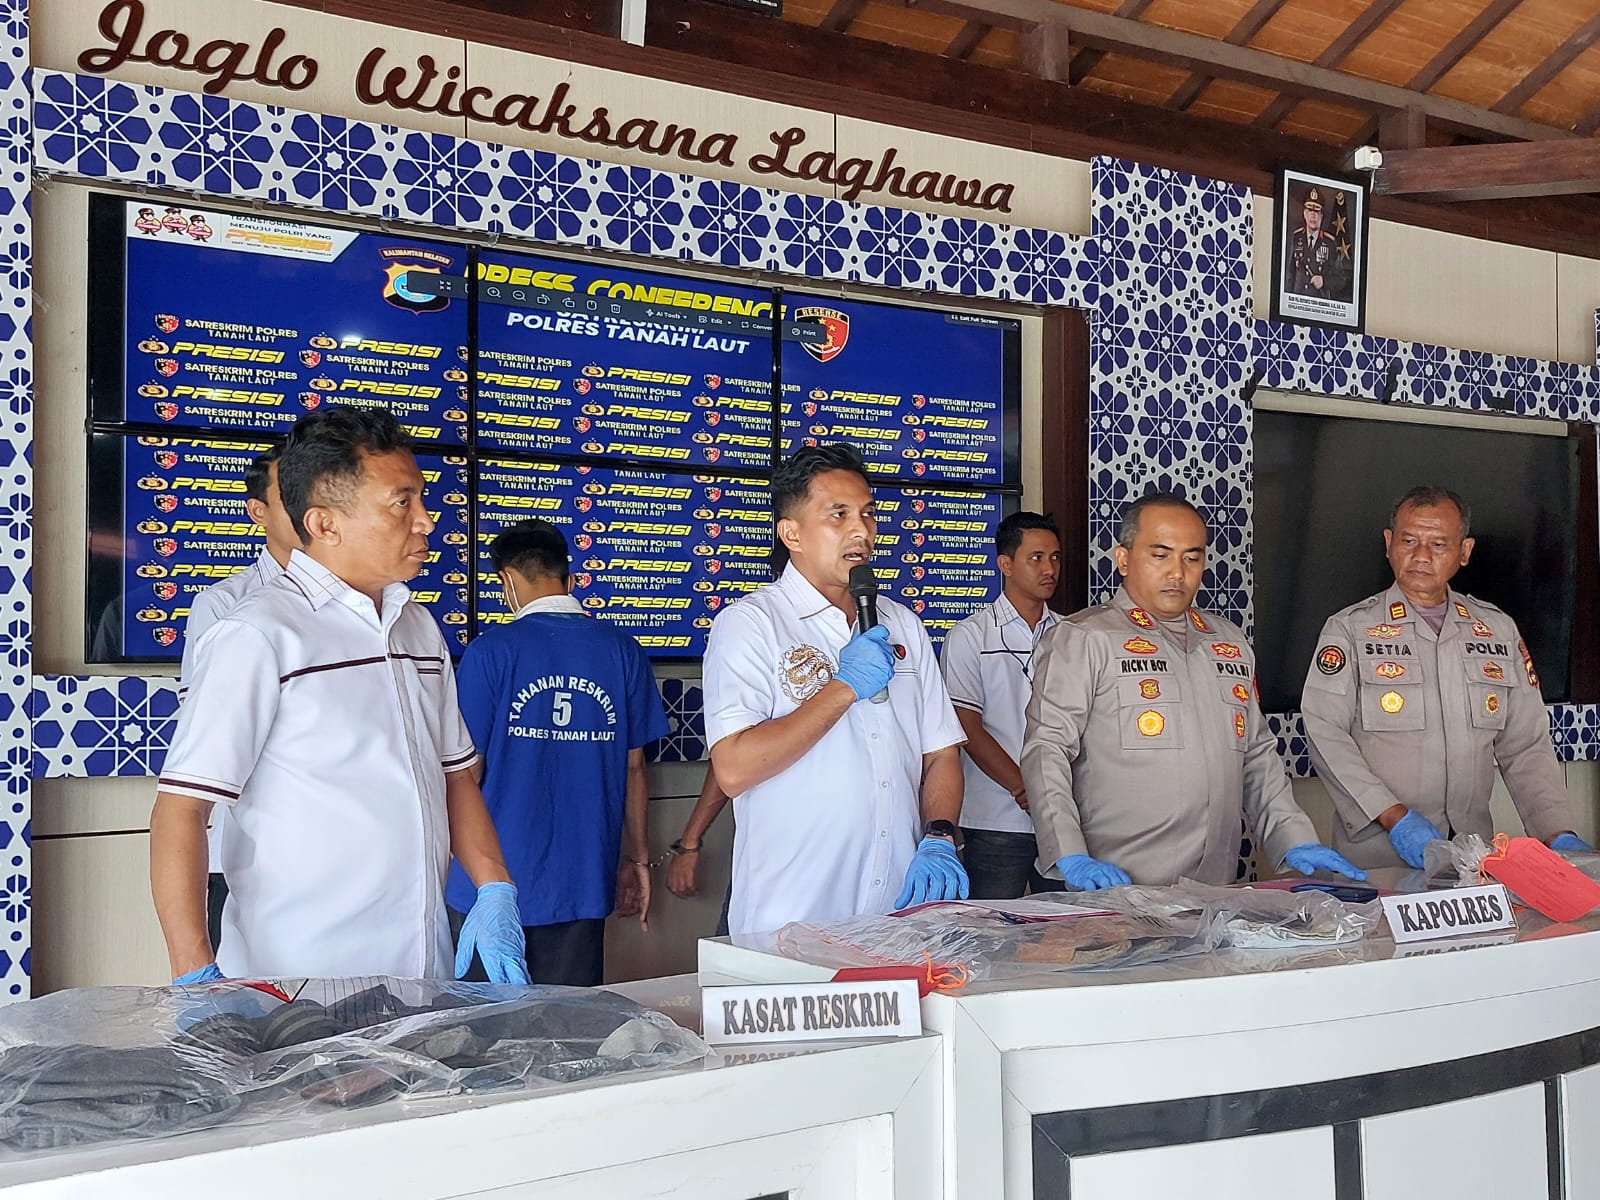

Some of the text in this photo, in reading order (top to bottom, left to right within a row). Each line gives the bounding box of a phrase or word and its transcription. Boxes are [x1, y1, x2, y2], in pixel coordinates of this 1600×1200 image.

[77, 0, 1016, 213] Joglo Wicaksana Laghawa
[230, 222, 271, 232] MENUJU
[665, 312, 681, 320] Tools
[802, 309, 842, 320] RESERSE
[185, 319, 298, 338] SATRESKRIM POLRES
[507, 312, 599, 336] POLRES
[607, 324, 689, 347] TANAH
[693, 336, 750, 354] LAUT
[803, 329, 817, 337] Print
[209, 330, 276, 343] TANAH LAUT
[172, 342, 285, 363] PRESISI
[340, 338, 442, 358] PRESISI
[327, 354, 430, 371] SATRESKRIM POLRES
[479, 350, 572, 368] SATRESKRIM POLRES
[185, 363, 298, 380] SATRESKRIM POLRES
[349, 364, 409, 376] TANAH LAUT
[498, 361, 554, 372] TANAH LAUT
[209, 373, 245, 383] TANAH
[607, 367, 692, 386] PRESISI
[340, 379, 442, 399] PRESISI
[725, 378, 772, 388] SATRESKRIM
[172, 386, 285, 406] PRESISI
[595, 382, 681, 398] SATRESKRIM POLRES
[741, 386, 766, 394] TANAH
[478, 390, 572, 406] SATRESKRIM POLRES
[613, 391, 665, 403] TANAH LAUT
[831, 390, 901, 406] PRESISI
[929, 397, 996, 409] SATRESKRIM POLRES
[326, 396, 429, 412] SATRESKRIM POLRES
[498, 400, 554, 411] TANAH LAUT
[185, 406, 297, 422] SATRESKRIM POLRES
[607, 405, 692, 422] PRESISI
[821, 405, 892, 417] SATRESKRIM POLRES
[209, 417, 275, 428] TANAH LAUT
[724, 414, 771, 425] SATRESKRIM
[922, 415, 988, 429] PRESISI
[595, 420, 681, 434] SATRESKRIM POLRES
[831, 425, 901, 440] PRESISI
[478, 430, 572, 444] SATRESKRIM POLRES
[613, 429, 665, 439] TANAH LAUT
[929, 431, 969, 440] SATRESKRIM
[497, 439, 553, 450] TANAH LAUT
[866, 443, 892, 451] POLRES
[607, 442, 691, 460] PRESISI
[724, 450, 770, 460] SATRESKRIM
[922, 448, 988, 462] PRESISI
[184, 454, 252, 465] SATRESKRIM
[208, 464, 245, 472] TANAH
[614, 470, 642, 478] TANAH
[929, 465, 969, 473] SATRESKRIM
[480, 473, 573, 486] SATRESKRIM POLRES
[499, 482, 529, 490] TANAH
[608, 484, 692, 500] PRESISI
[725, 490, 771, 500] SATRESKRIM
[208, 507, 244, 515] TANAH
[597, 500, 682, 511] SATRESKRIM POLRES
[608, 522, 692, 536] PRESISI
[725, 526, 771, 535] SATRESKRIM
[920, 520, 988, 532] PRESISI
[184, 541, 251, 550] SATRESKRIM
[596, 537, 682, 548] SATRESKRIM POLRES
[614, 545, 642, 553] TANAH
[921, 553, 988, 564] PRESISI
[607, 559, 692, 572] PRESISI
[596, 575, 648, 583] SATRESKRIM
[921, 586, 988, 597] PRESISI
[607, 596, 692, 608] PRESISI
[1365, 642, 1412, 656] SETIA
[1466, 642, 1509, 657] POLRI
[1121, 659, 1148, 673] RICKY
[1216, 662, 1250, 679] POLRI
[509, 675, 617, 725] TAHANAN RESKRIM
[552, 691, 572, 726] 5
[508, 726, 615, 741] POLRES TANAH LAUT
[1397, 894, 1503, 932] KAPOLRES
[723, 991, 900, 1035] KASAT RESKRIM
